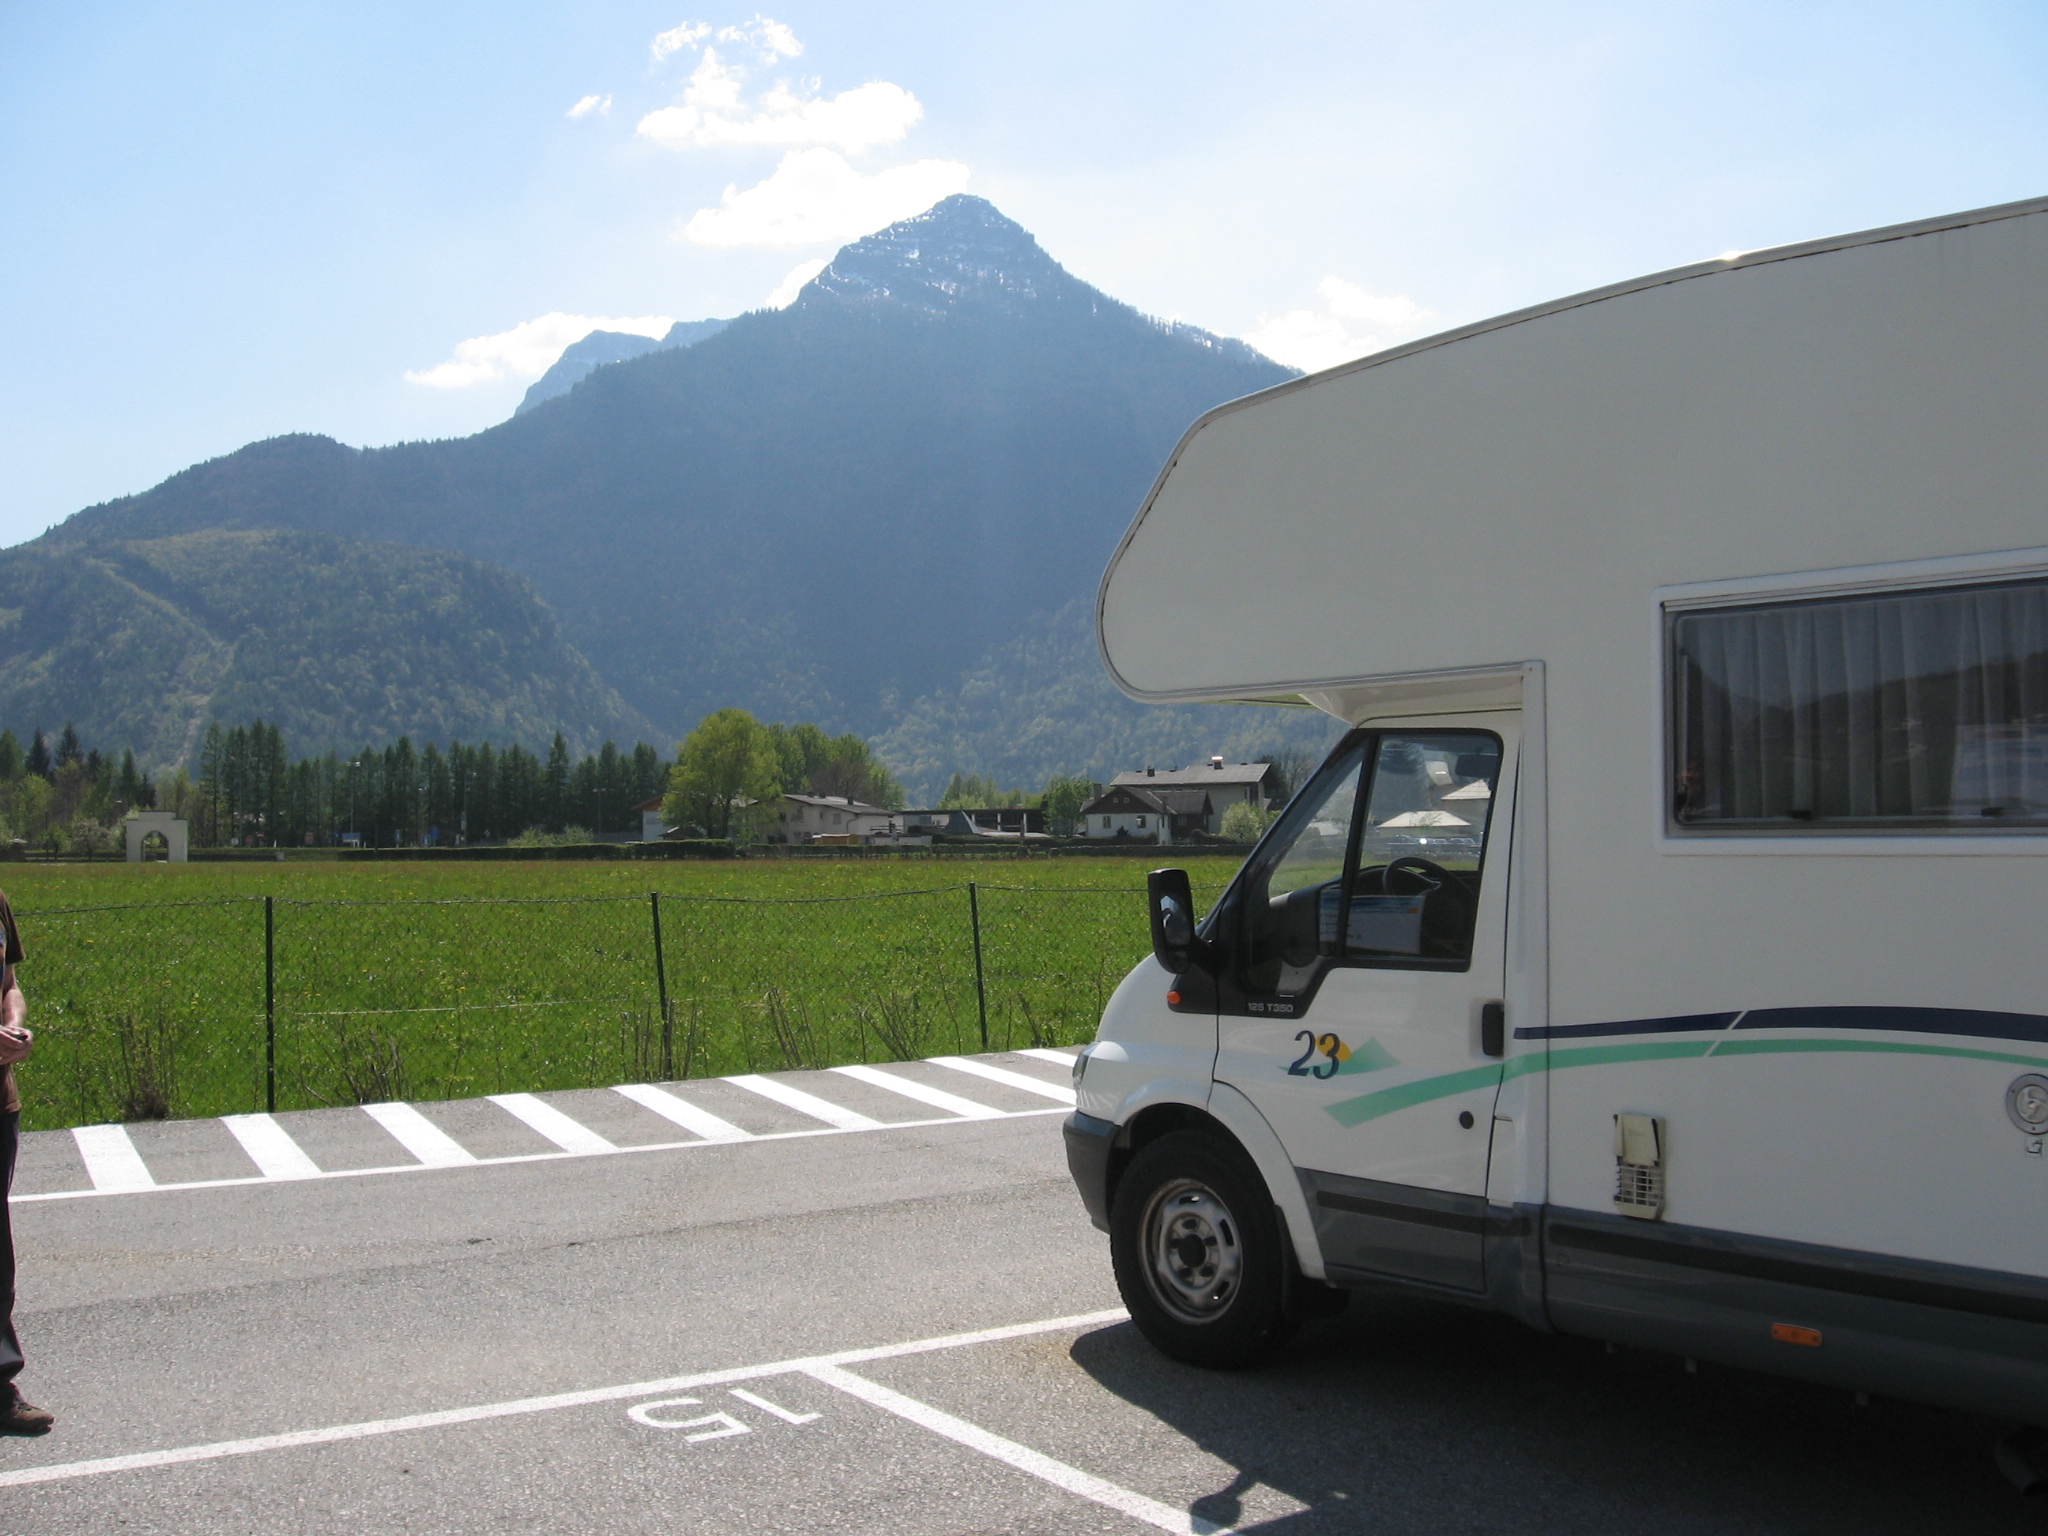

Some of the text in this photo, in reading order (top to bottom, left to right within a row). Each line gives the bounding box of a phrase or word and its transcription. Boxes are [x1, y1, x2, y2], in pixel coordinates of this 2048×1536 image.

[1267, 1003, 1294, 1013] T350
[1287, 1030, 1340, 1080] 23
[627, 1388, 824, 1443] 15
